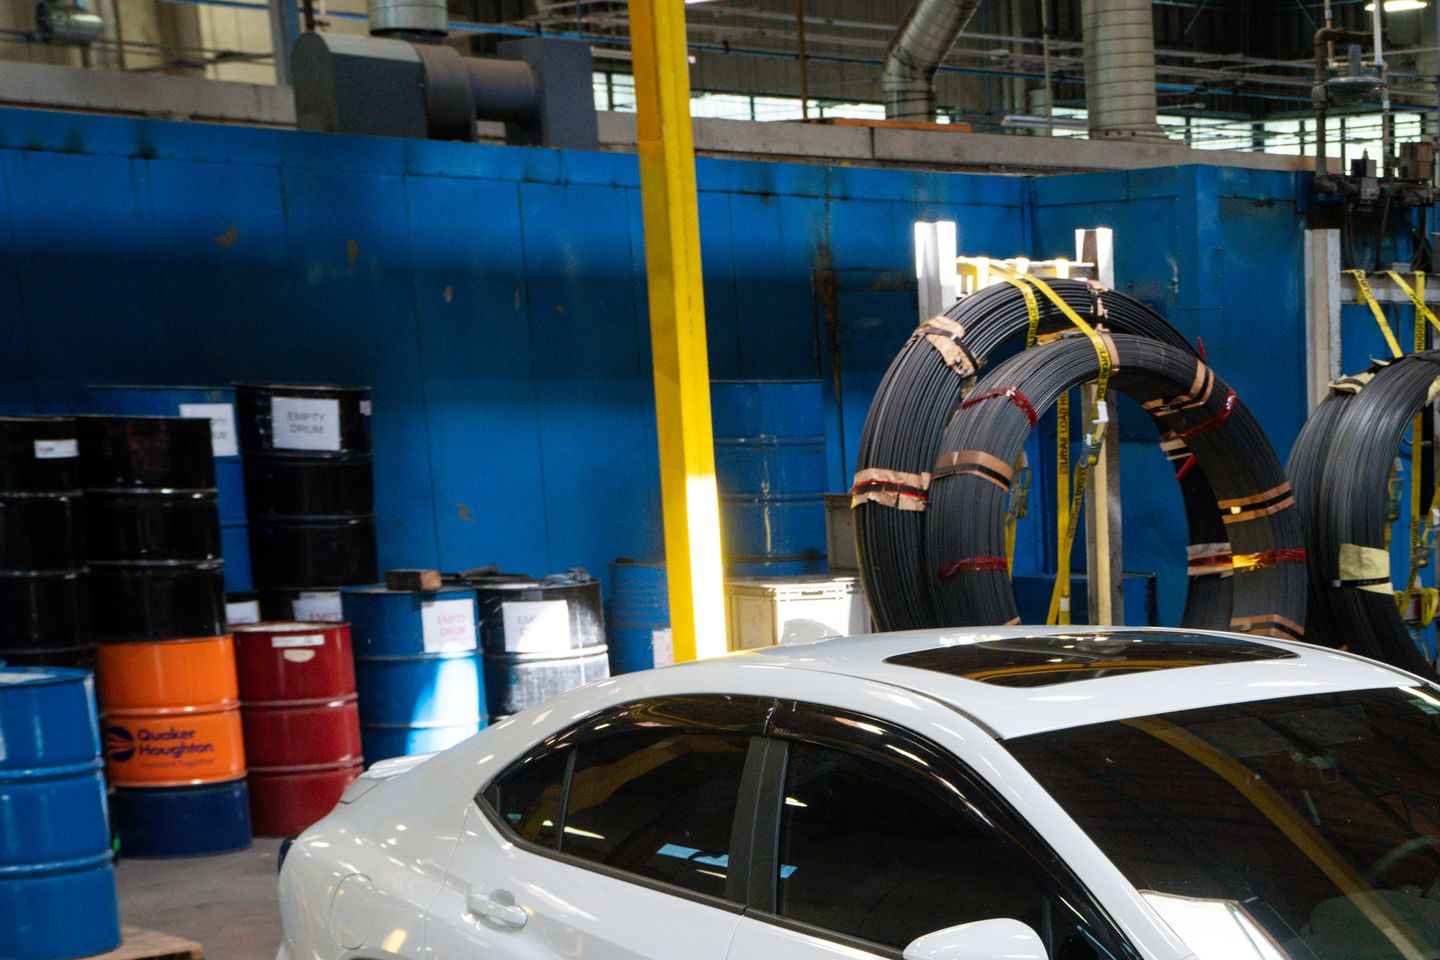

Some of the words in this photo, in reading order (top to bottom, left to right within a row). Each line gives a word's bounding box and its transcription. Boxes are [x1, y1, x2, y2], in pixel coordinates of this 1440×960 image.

[287, 412, 325, 422] EMPTY
[1059, 407, 1067, 433] LOAD
[290, 424, 324, 434] DRUM
[309, 612, 338, 621] EMPT
[437, 615, 466, 625] EMPTY
[440, 626, 466, 635] DRUM
[137, 728, 195, 741] Quaker
[140, 742, 214, 758] Houghton
